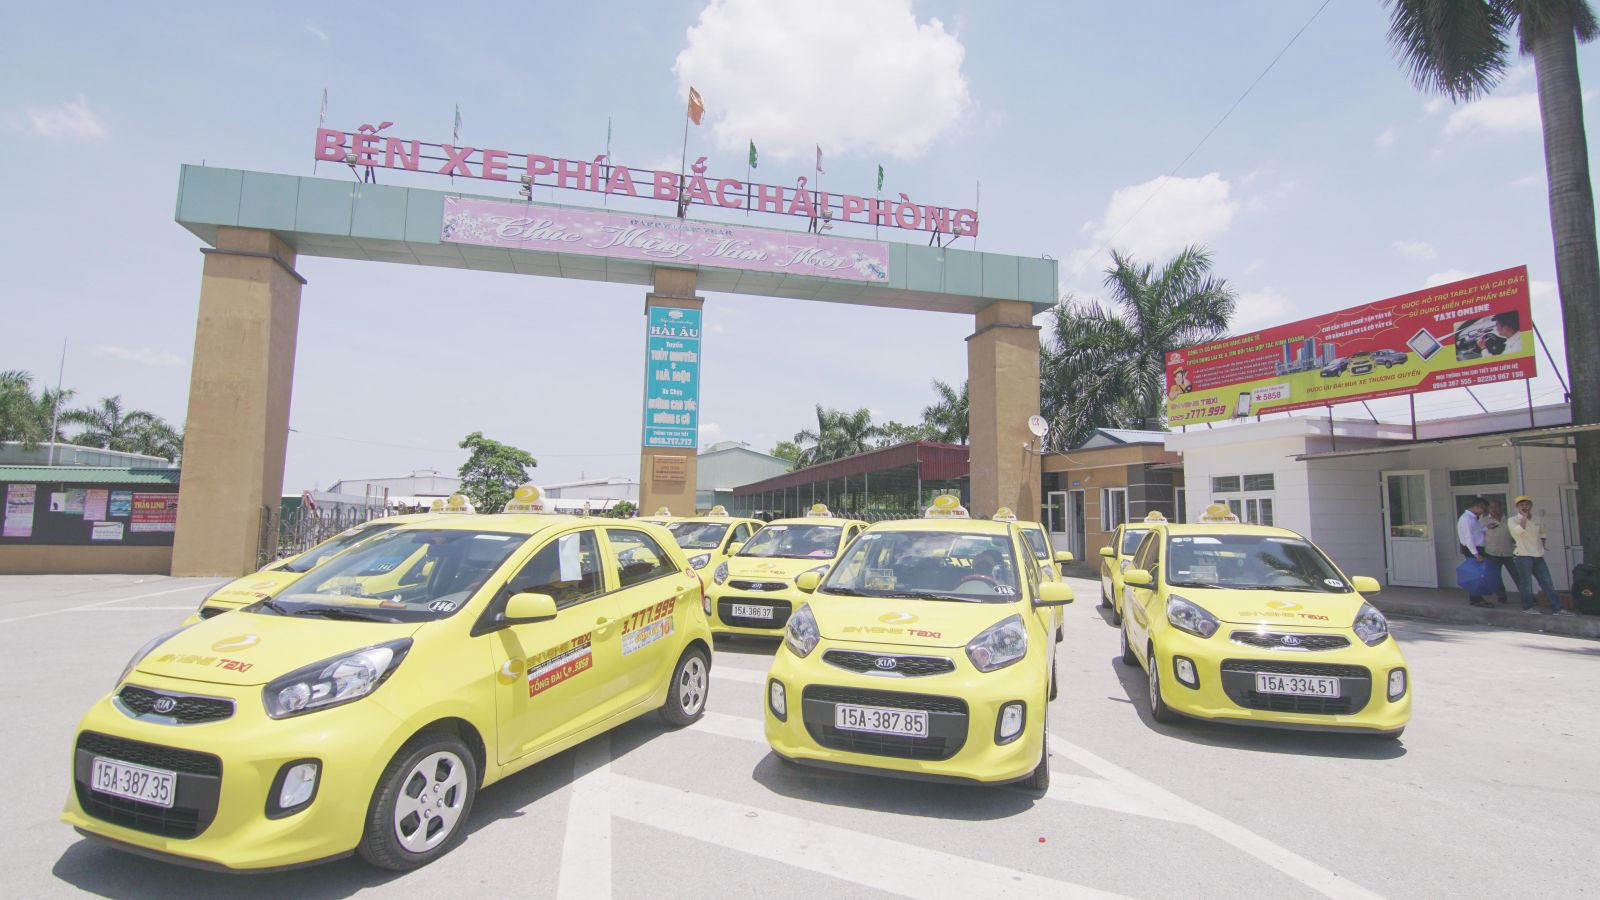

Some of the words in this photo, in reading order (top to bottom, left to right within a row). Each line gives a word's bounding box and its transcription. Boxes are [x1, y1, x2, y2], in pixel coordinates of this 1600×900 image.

[315, 121, 420, 171] BẾN
[438, 144, 509, 181] XE
[526, 154, 637, 196] PHÍA
[653, 156, 743, 208] BẮC
[758, 176, 829, 218] HẢI
[842, 192, 979, 237] PHÒNG
[1450, 287, 1478, 299] TABLET
[1433, 311, 1456, 322] TAXI
[1456, 303, 1491, 318] ONLINE
[651, 323, 675, 336] HẢI
[679, 325, 698, 337] ÂU
[1260, 675, 1335, 696] 15A-334.51
[840, 708, 923, 733] 15A-387.85
[97, 763, 170, 801] 15A-387.35
